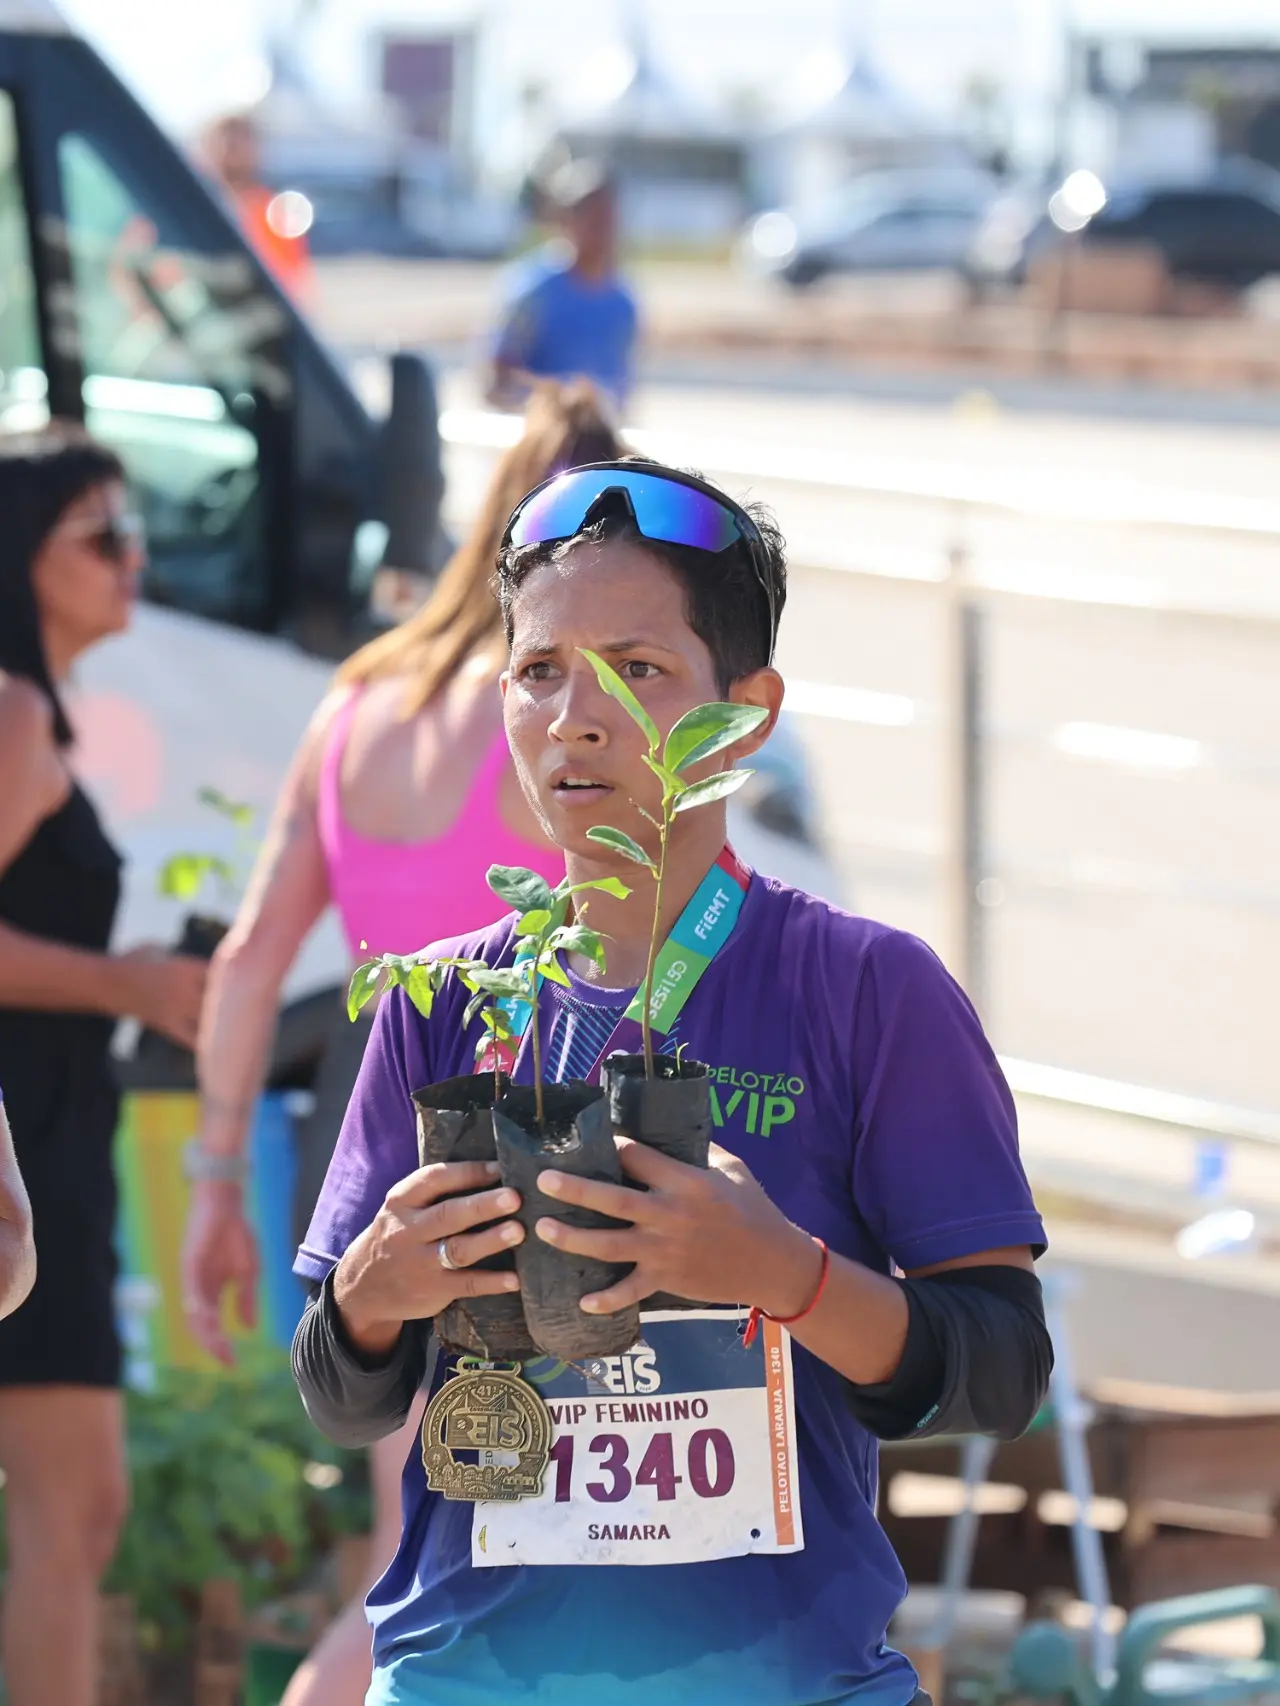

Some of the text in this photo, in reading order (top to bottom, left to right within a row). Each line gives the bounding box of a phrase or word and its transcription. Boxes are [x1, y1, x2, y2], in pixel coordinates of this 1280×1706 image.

[709, 1085, 795, 1138] VIP
[771, 1347, 780, 1374] 1340
[549, 1398, 709, 1425] VIP FEMININO
[774, 1389, 785, 1447] LARANJA
[550, 1428, 736, 1503] 1340
[588, 1524, 671, 1541] SAMARA
